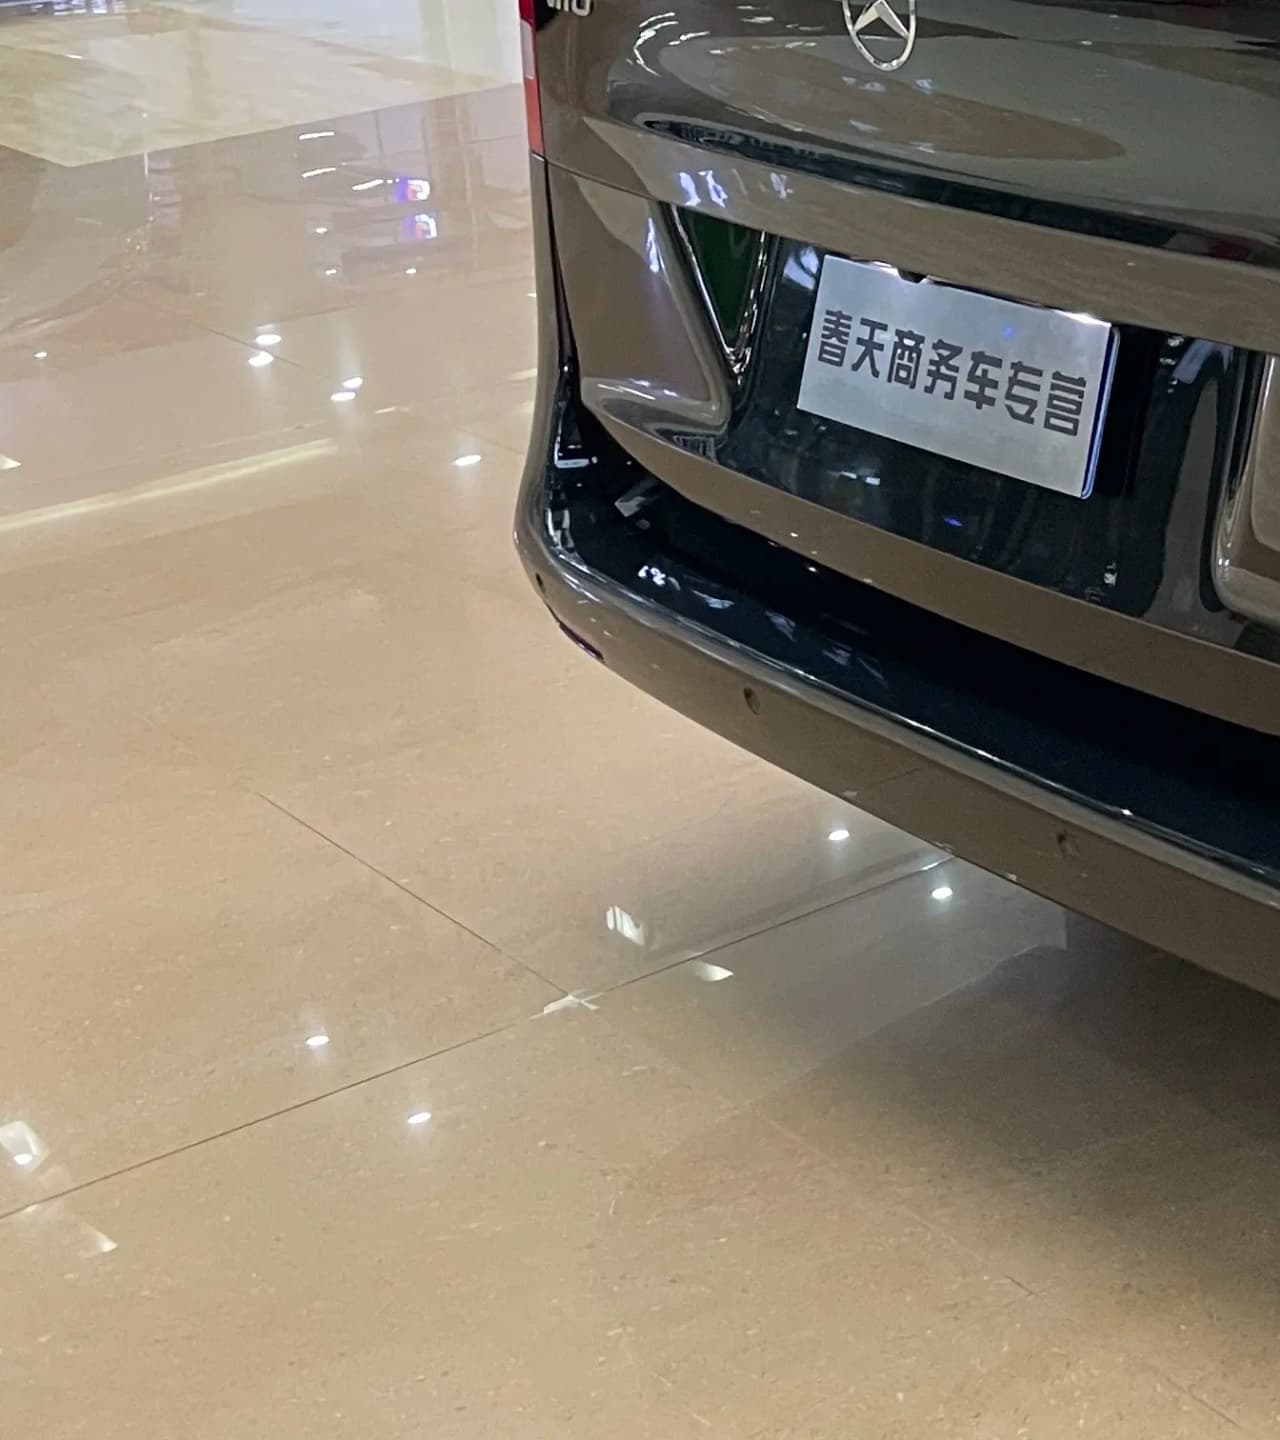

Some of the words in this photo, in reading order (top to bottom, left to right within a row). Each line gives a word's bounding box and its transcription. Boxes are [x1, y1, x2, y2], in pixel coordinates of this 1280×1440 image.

[816, 308, 1088, 438] 春天商务车专营
